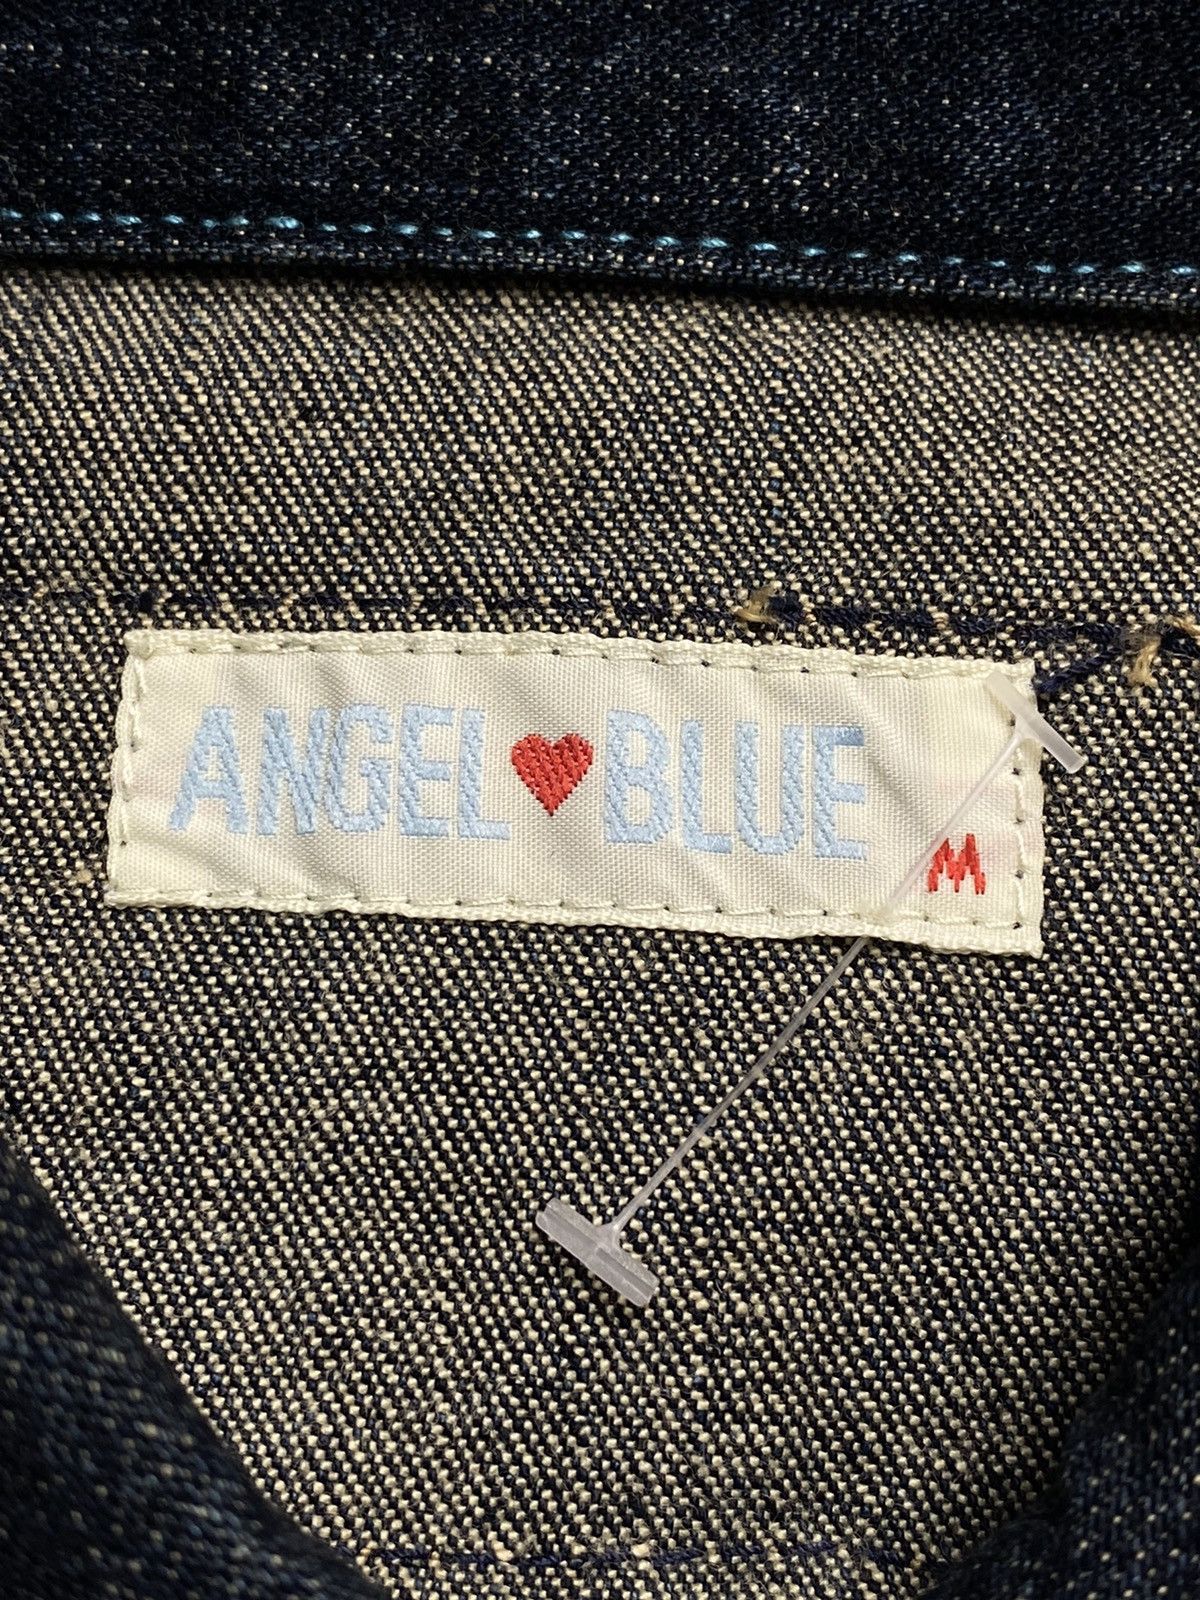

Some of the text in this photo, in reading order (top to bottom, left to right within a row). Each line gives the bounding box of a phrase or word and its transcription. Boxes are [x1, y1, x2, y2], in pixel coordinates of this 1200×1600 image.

[168, 704, 867, 859] ANGEL BLUE
[927, 832, 986, 895] M
